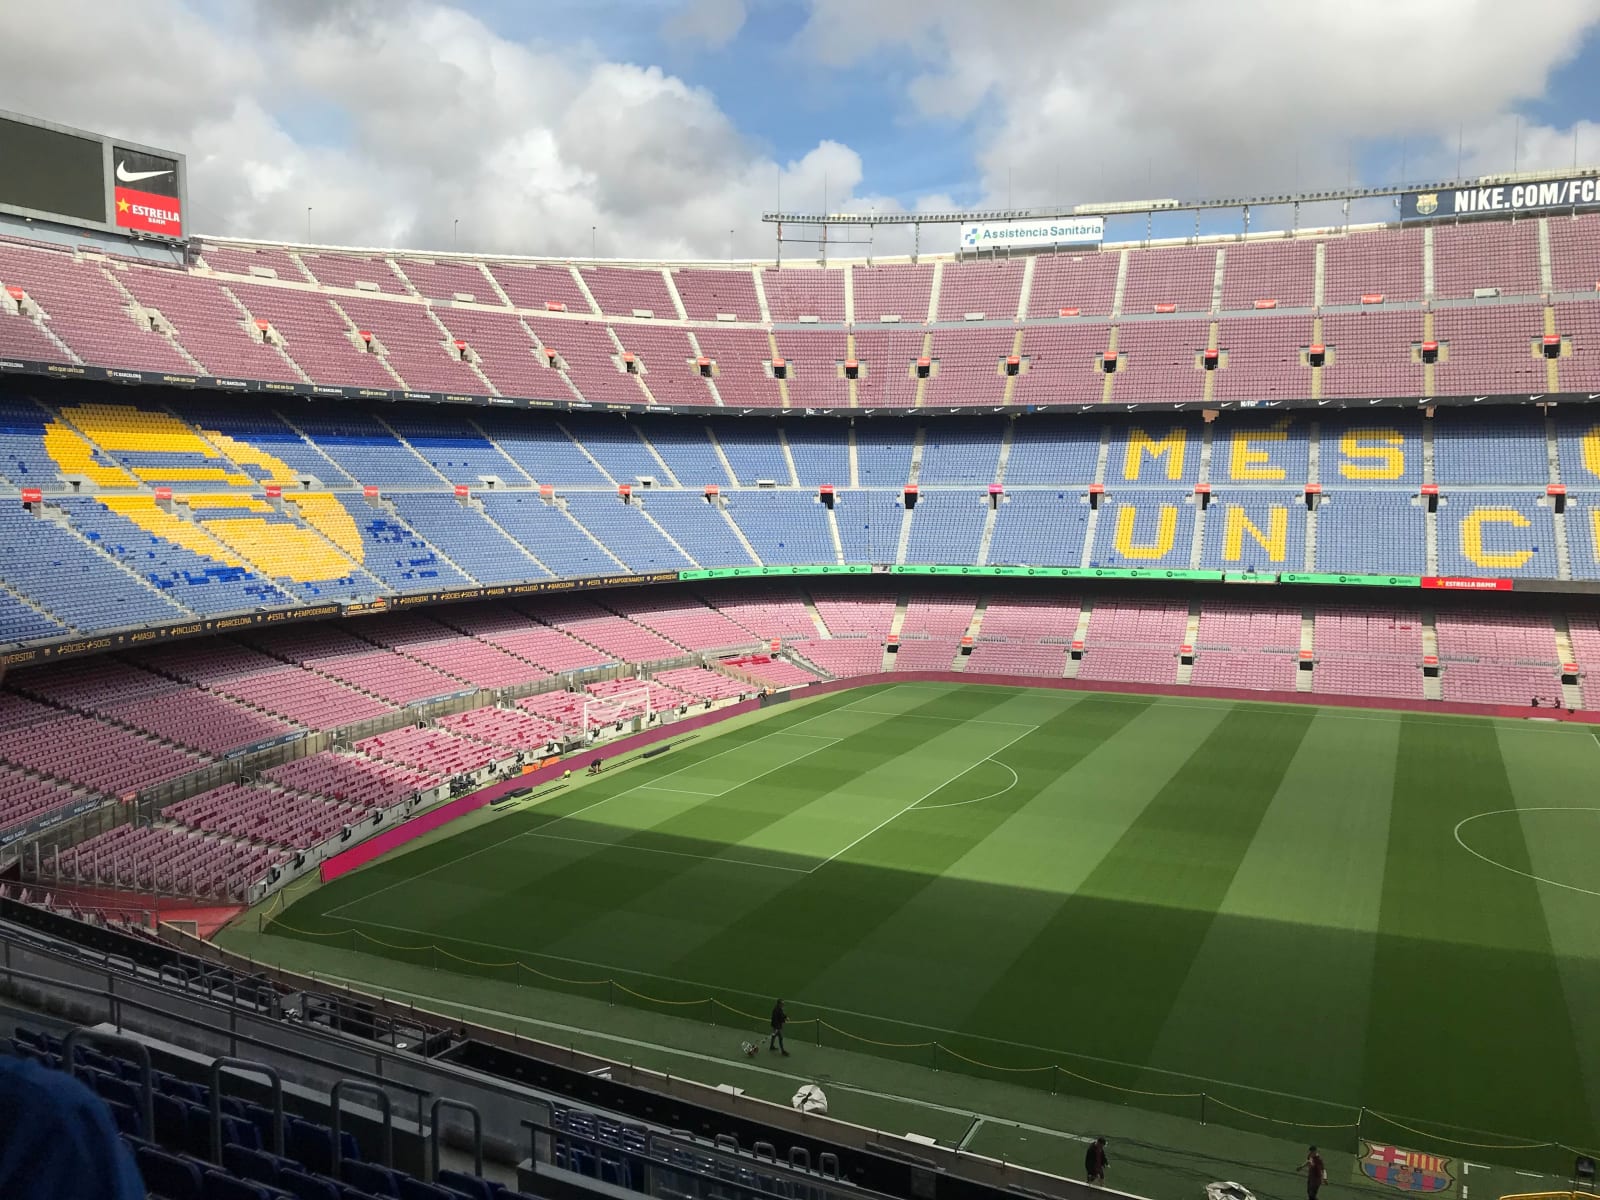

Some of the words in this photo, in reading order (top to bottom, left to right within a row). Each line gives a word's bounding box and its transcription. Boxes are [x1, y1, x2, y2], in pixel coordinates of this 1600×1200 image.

[132, 204, 180, 222] ESTRELLA
[983, 227, 1049, 239] Assistència
[1050, 225, 1101, 236] Sanitària
